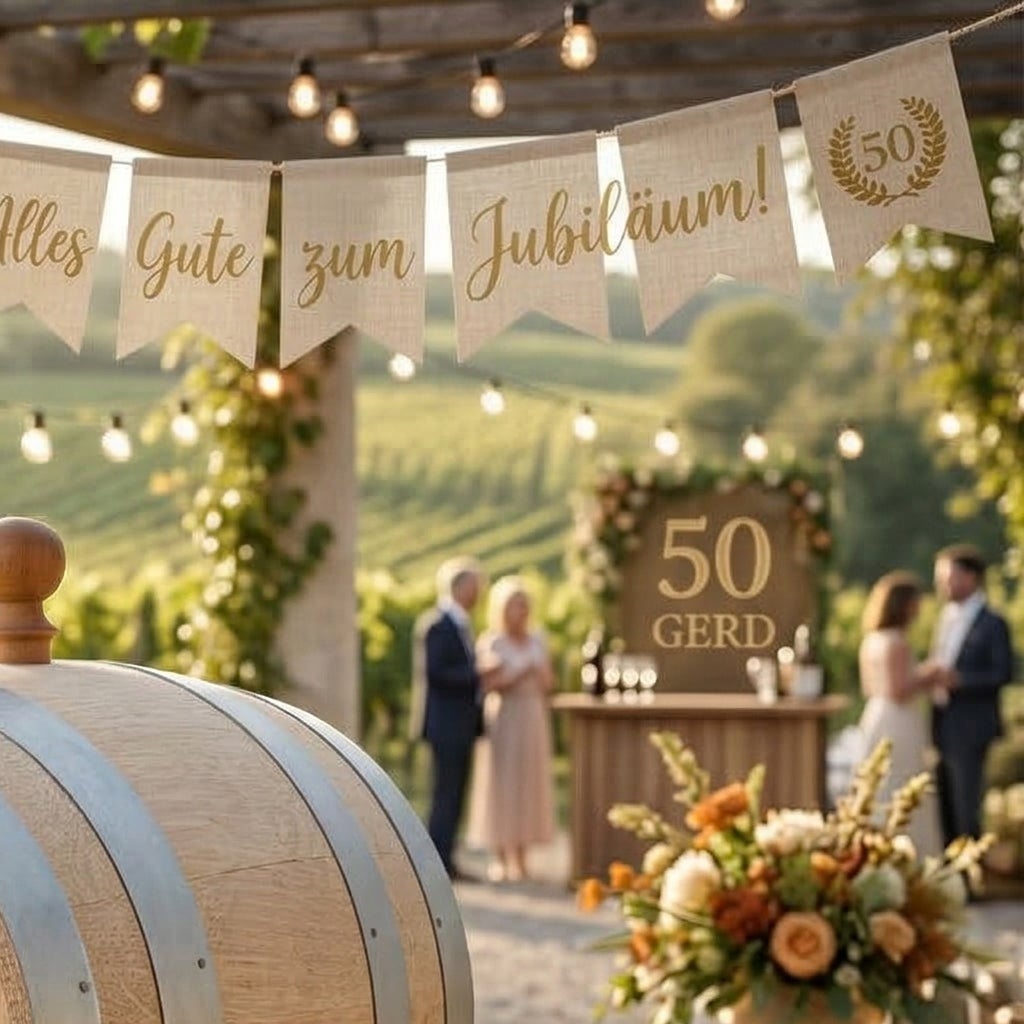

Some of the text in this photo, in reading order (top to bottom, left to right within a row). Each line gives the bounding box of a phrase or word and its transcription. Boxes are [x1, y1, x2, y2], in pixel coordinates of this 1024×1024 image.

[136, 212, 254, 300] Gute
[298, 236, 414, 309] zum
[467, 145, 769, 301] Jubiläum!
[862, 124, 916, 173] 50
[658, 516, 771, 599] 50
[652, 614, 776, 648] GERD
